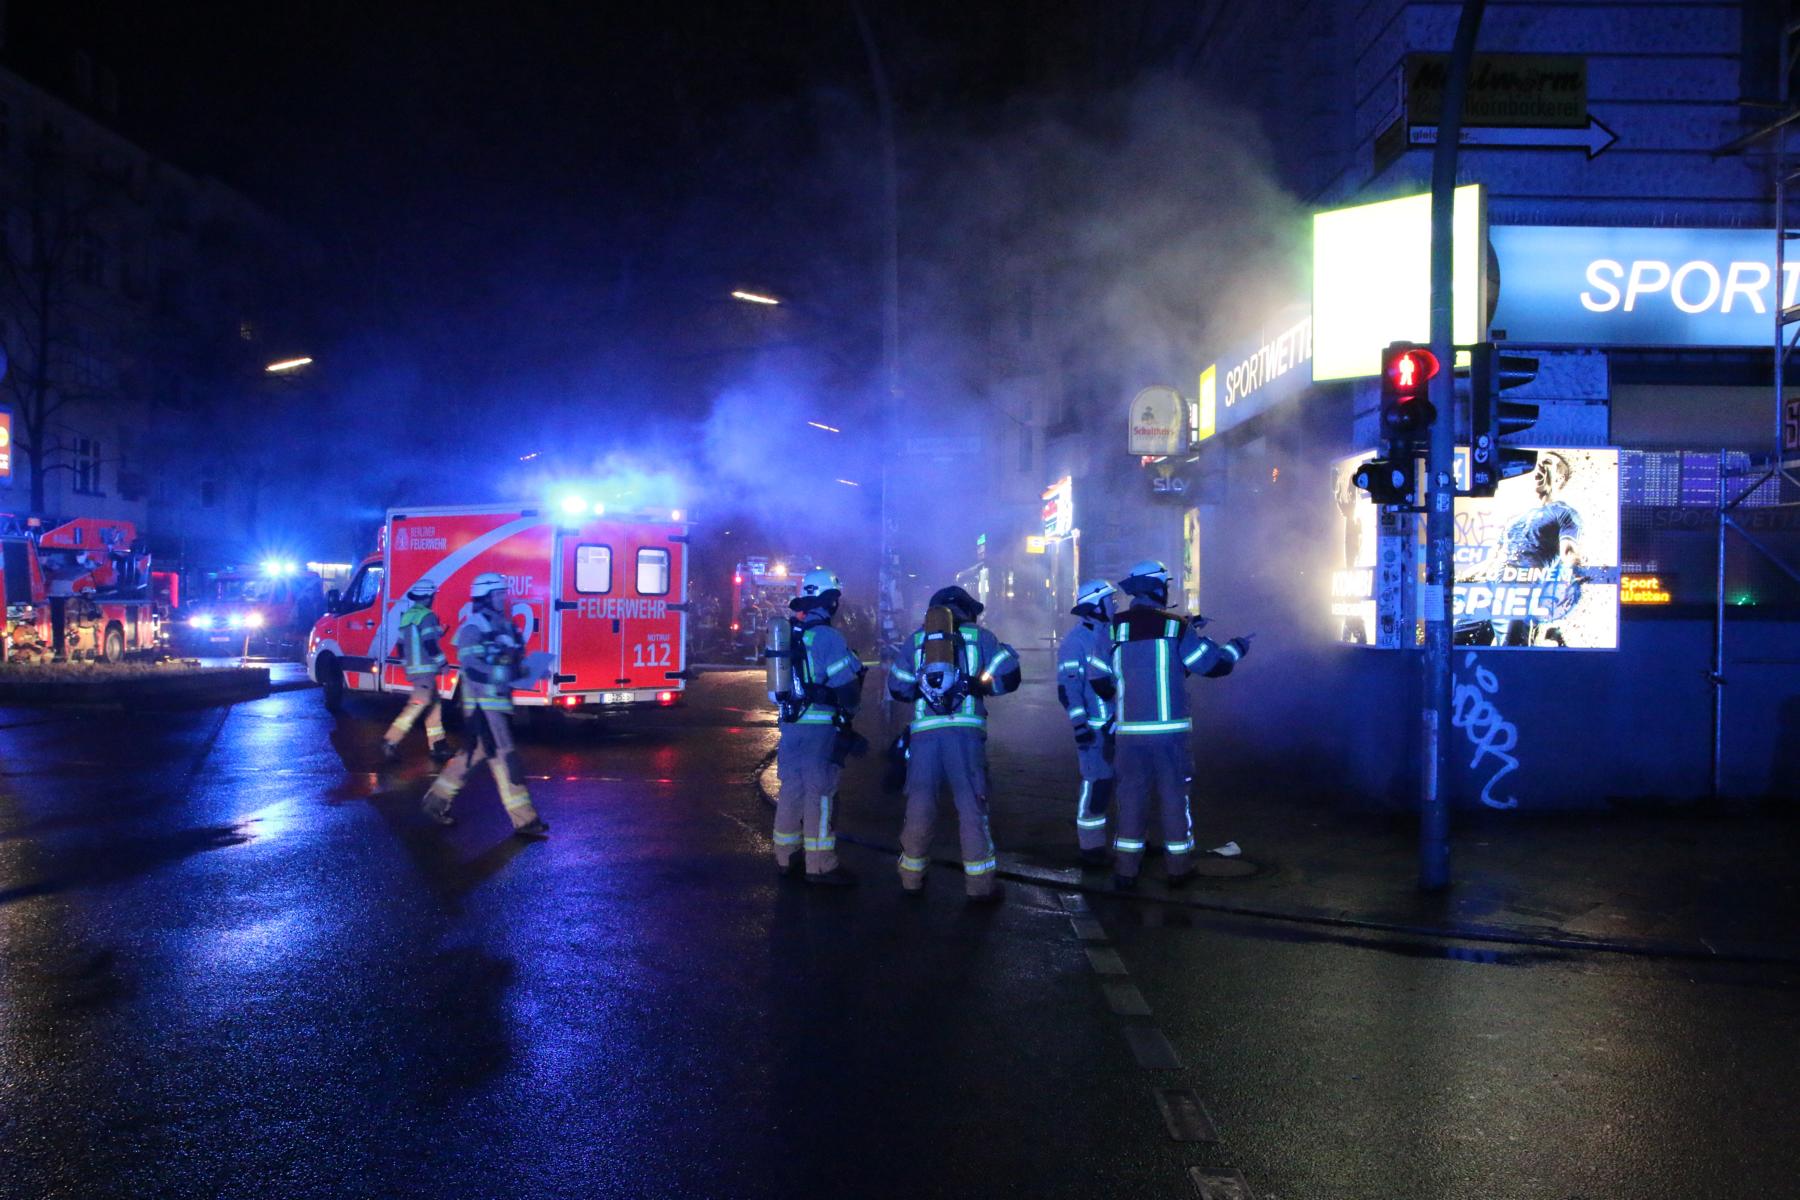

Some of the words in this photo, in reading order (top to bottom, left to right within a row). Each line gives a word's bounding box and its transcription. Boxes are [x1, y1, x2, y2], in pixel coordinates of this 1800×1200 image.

[410, 538, 447, 550] FEUERWEHR
[1621, 576, 1659, 592] Sport
[577, 598, 667, 619] FEUERWEHR
[1452, 587, 1549, 616] SPIEL
[633, 643, 671, 667] 112
